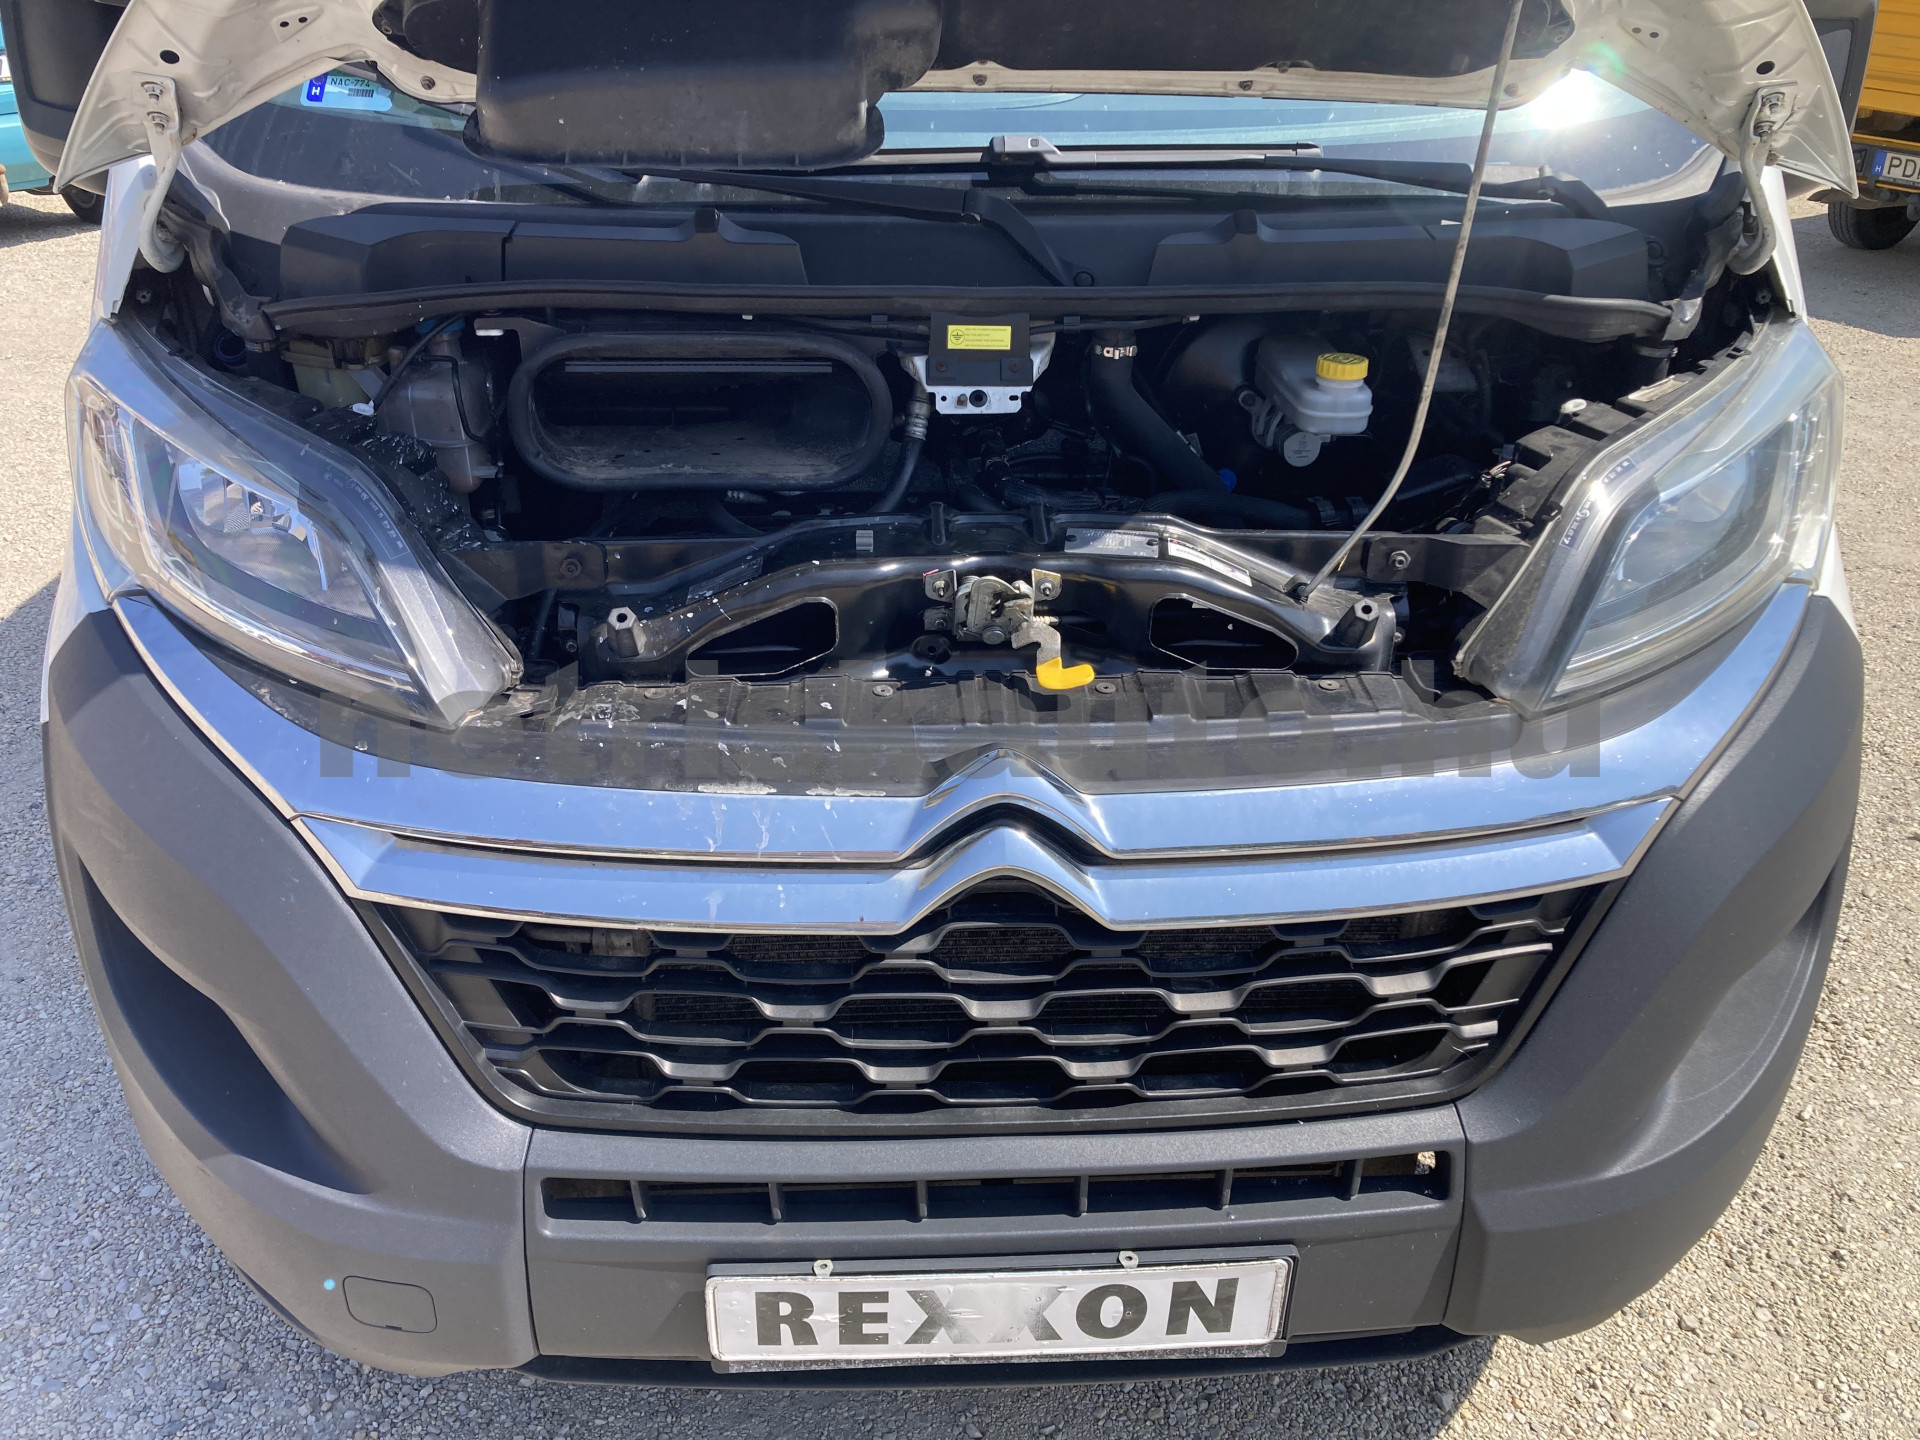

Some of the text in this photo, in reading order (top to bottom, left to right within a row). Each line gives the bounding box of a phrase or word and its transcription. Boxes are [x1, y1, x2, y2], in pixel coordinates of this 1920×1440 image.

[311, 86, 320, 96] H
[1875, 164, 1882, 173] H
[754, 1277, 1240, 1346] REXXON
